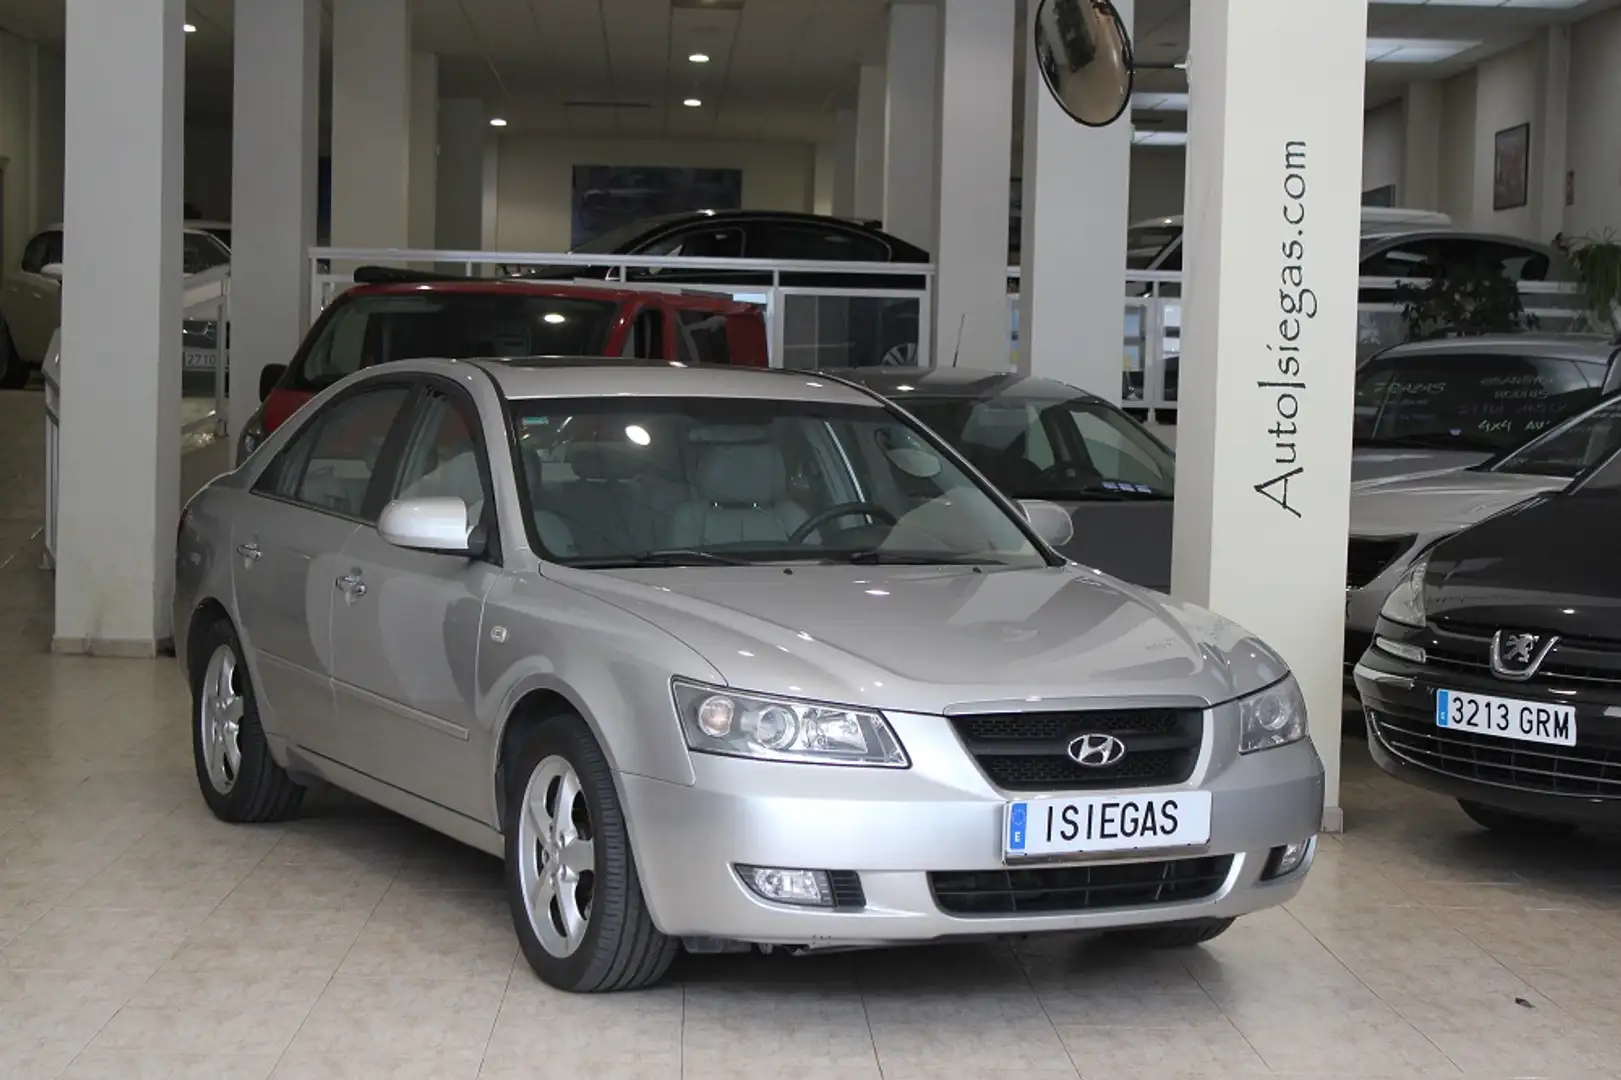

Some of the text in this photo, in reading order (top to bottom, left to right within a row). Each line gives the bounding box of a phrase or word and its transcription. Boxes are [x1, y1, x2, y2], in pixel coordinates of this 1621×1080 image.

[1451, 697, 1570, 740] 3213 GRM
[1014, 831, 1021, 843] E
[1046, 799, 1179, 843] ISIEGAS
